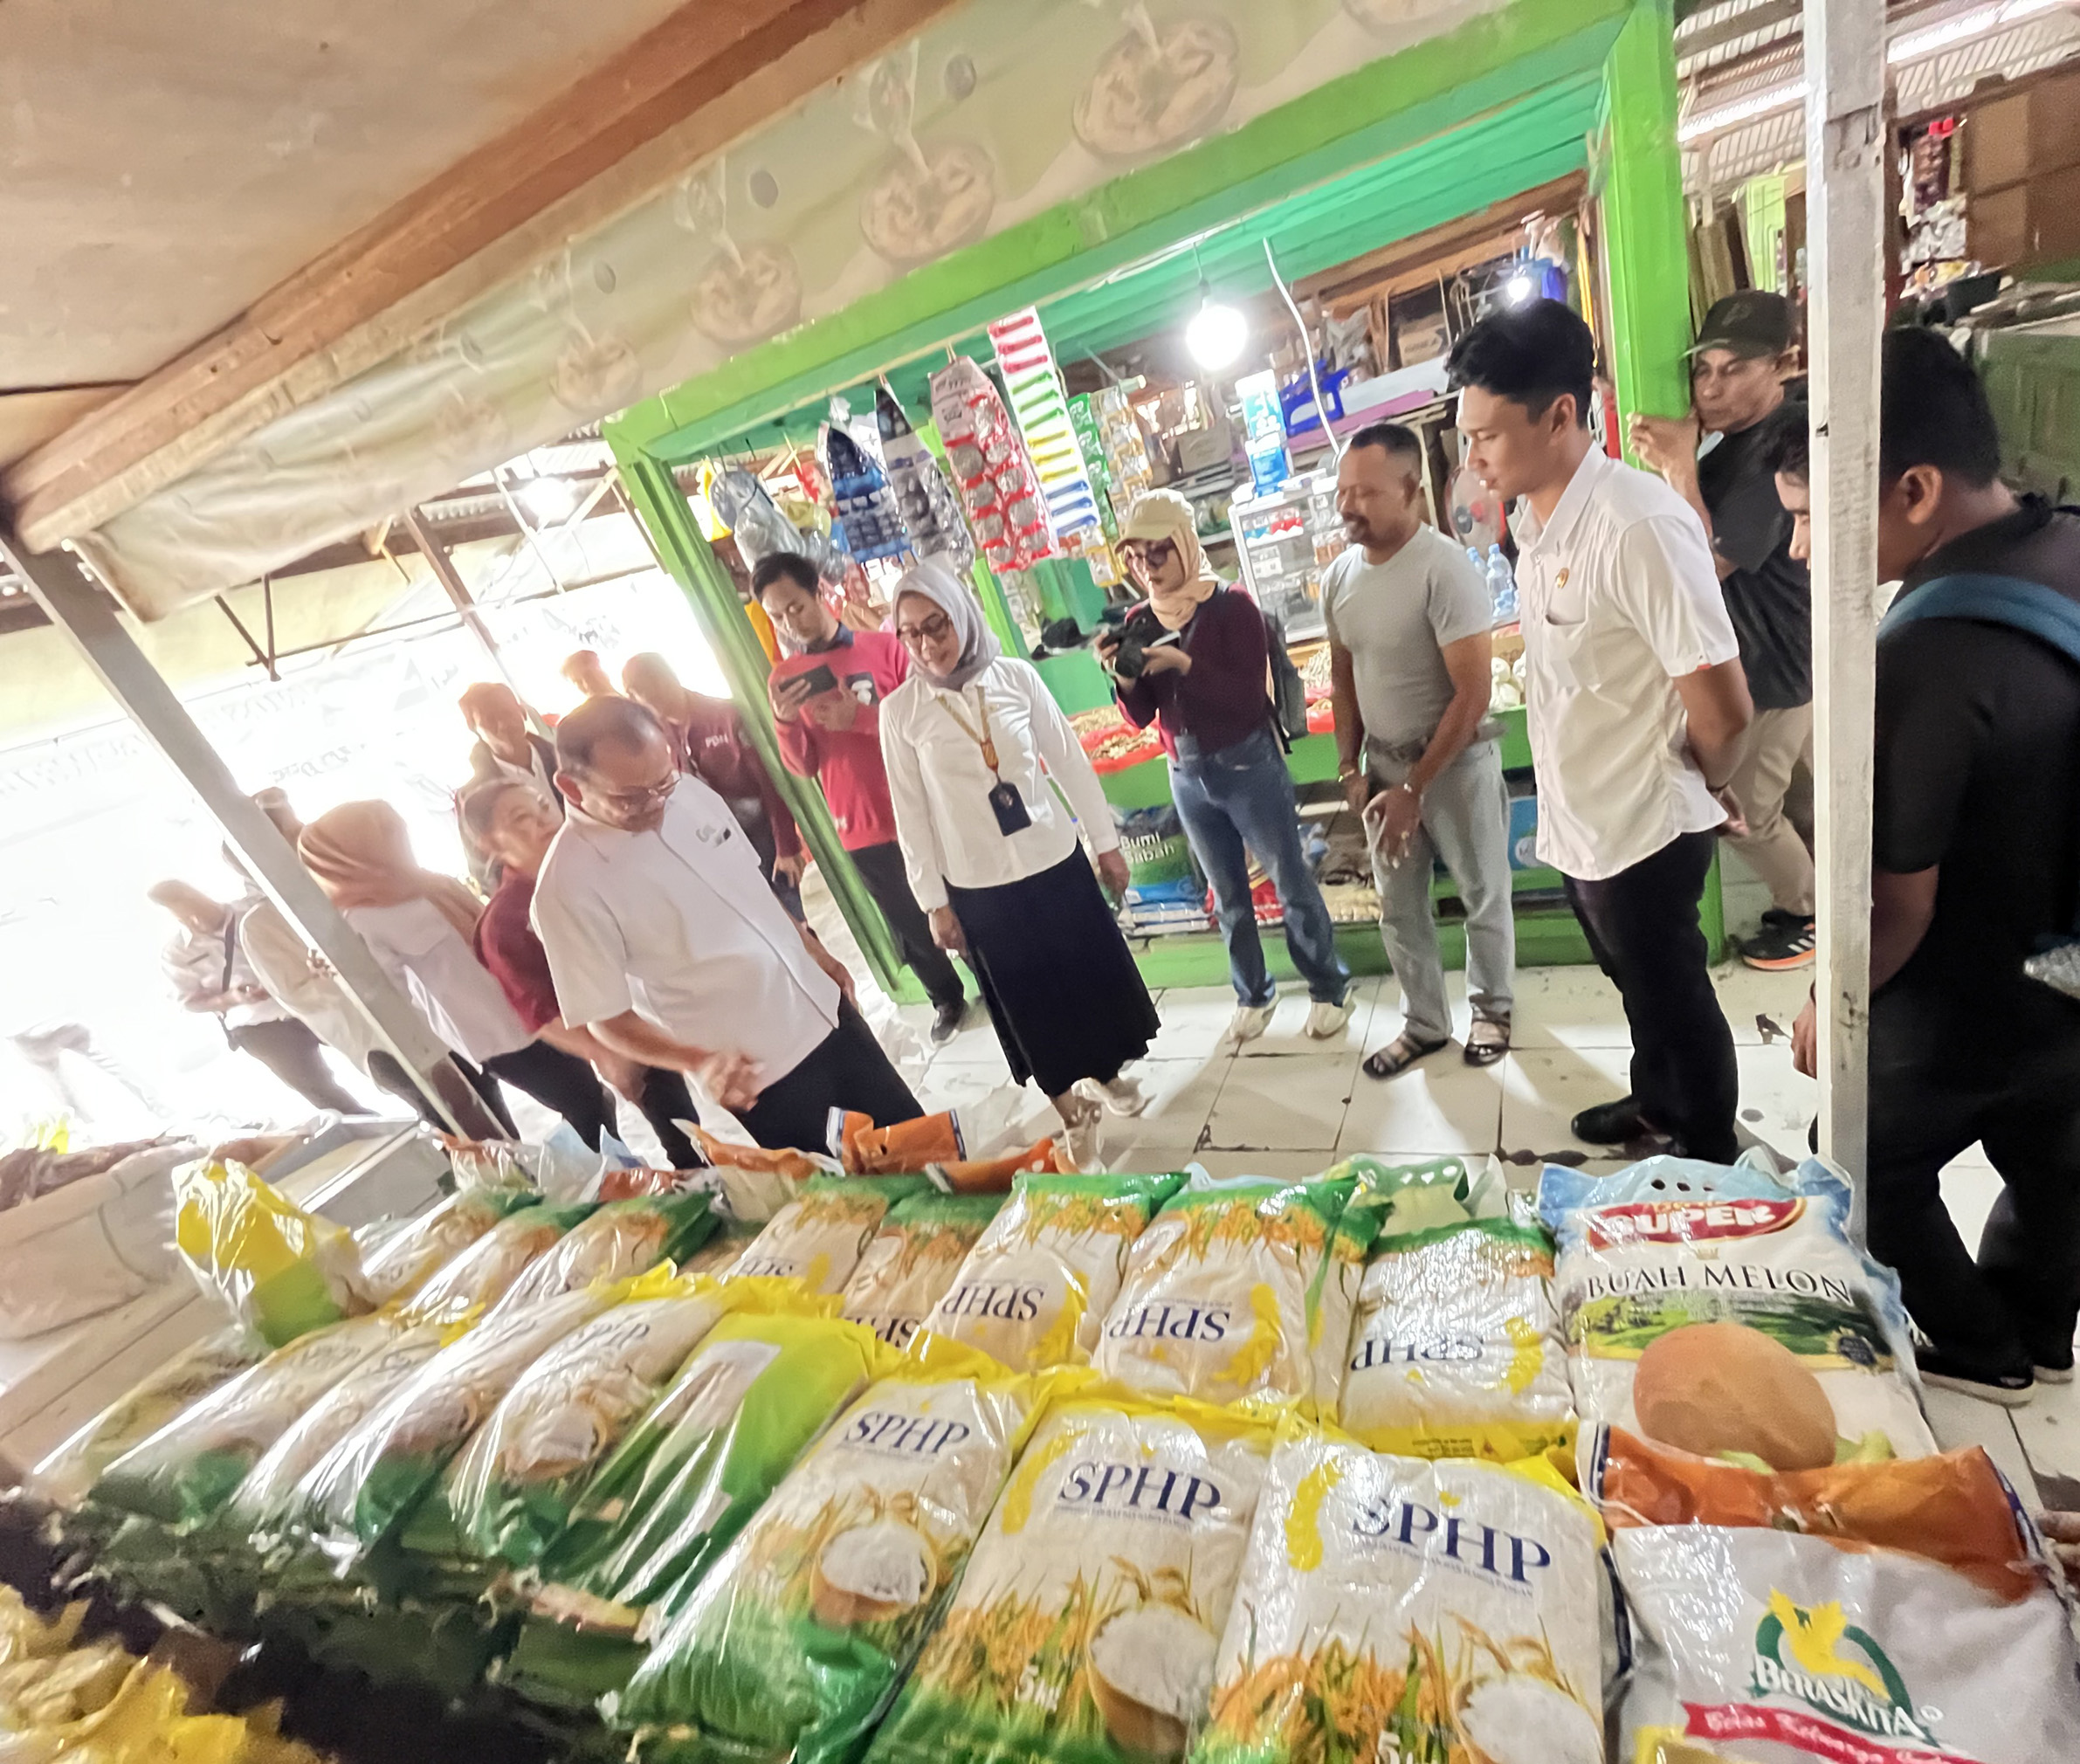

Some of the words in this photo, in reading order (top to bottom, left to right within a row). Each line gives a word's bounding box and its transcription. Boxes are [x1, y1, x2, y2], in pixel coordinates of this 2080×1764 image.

[941, 1285, 1044, 1321] SPHP
[1587, 1266, 1687, 1300] BUAH
[1704, 1264, 1855, 1307] MELON
[1109, 1306, 1230, 1342] SPHP
[844, 1411, 970, 1454] SPHP
[1057, 1461, 1222, 1521] SPHP
[1353, 1497, 1552, 1584] SPHP
